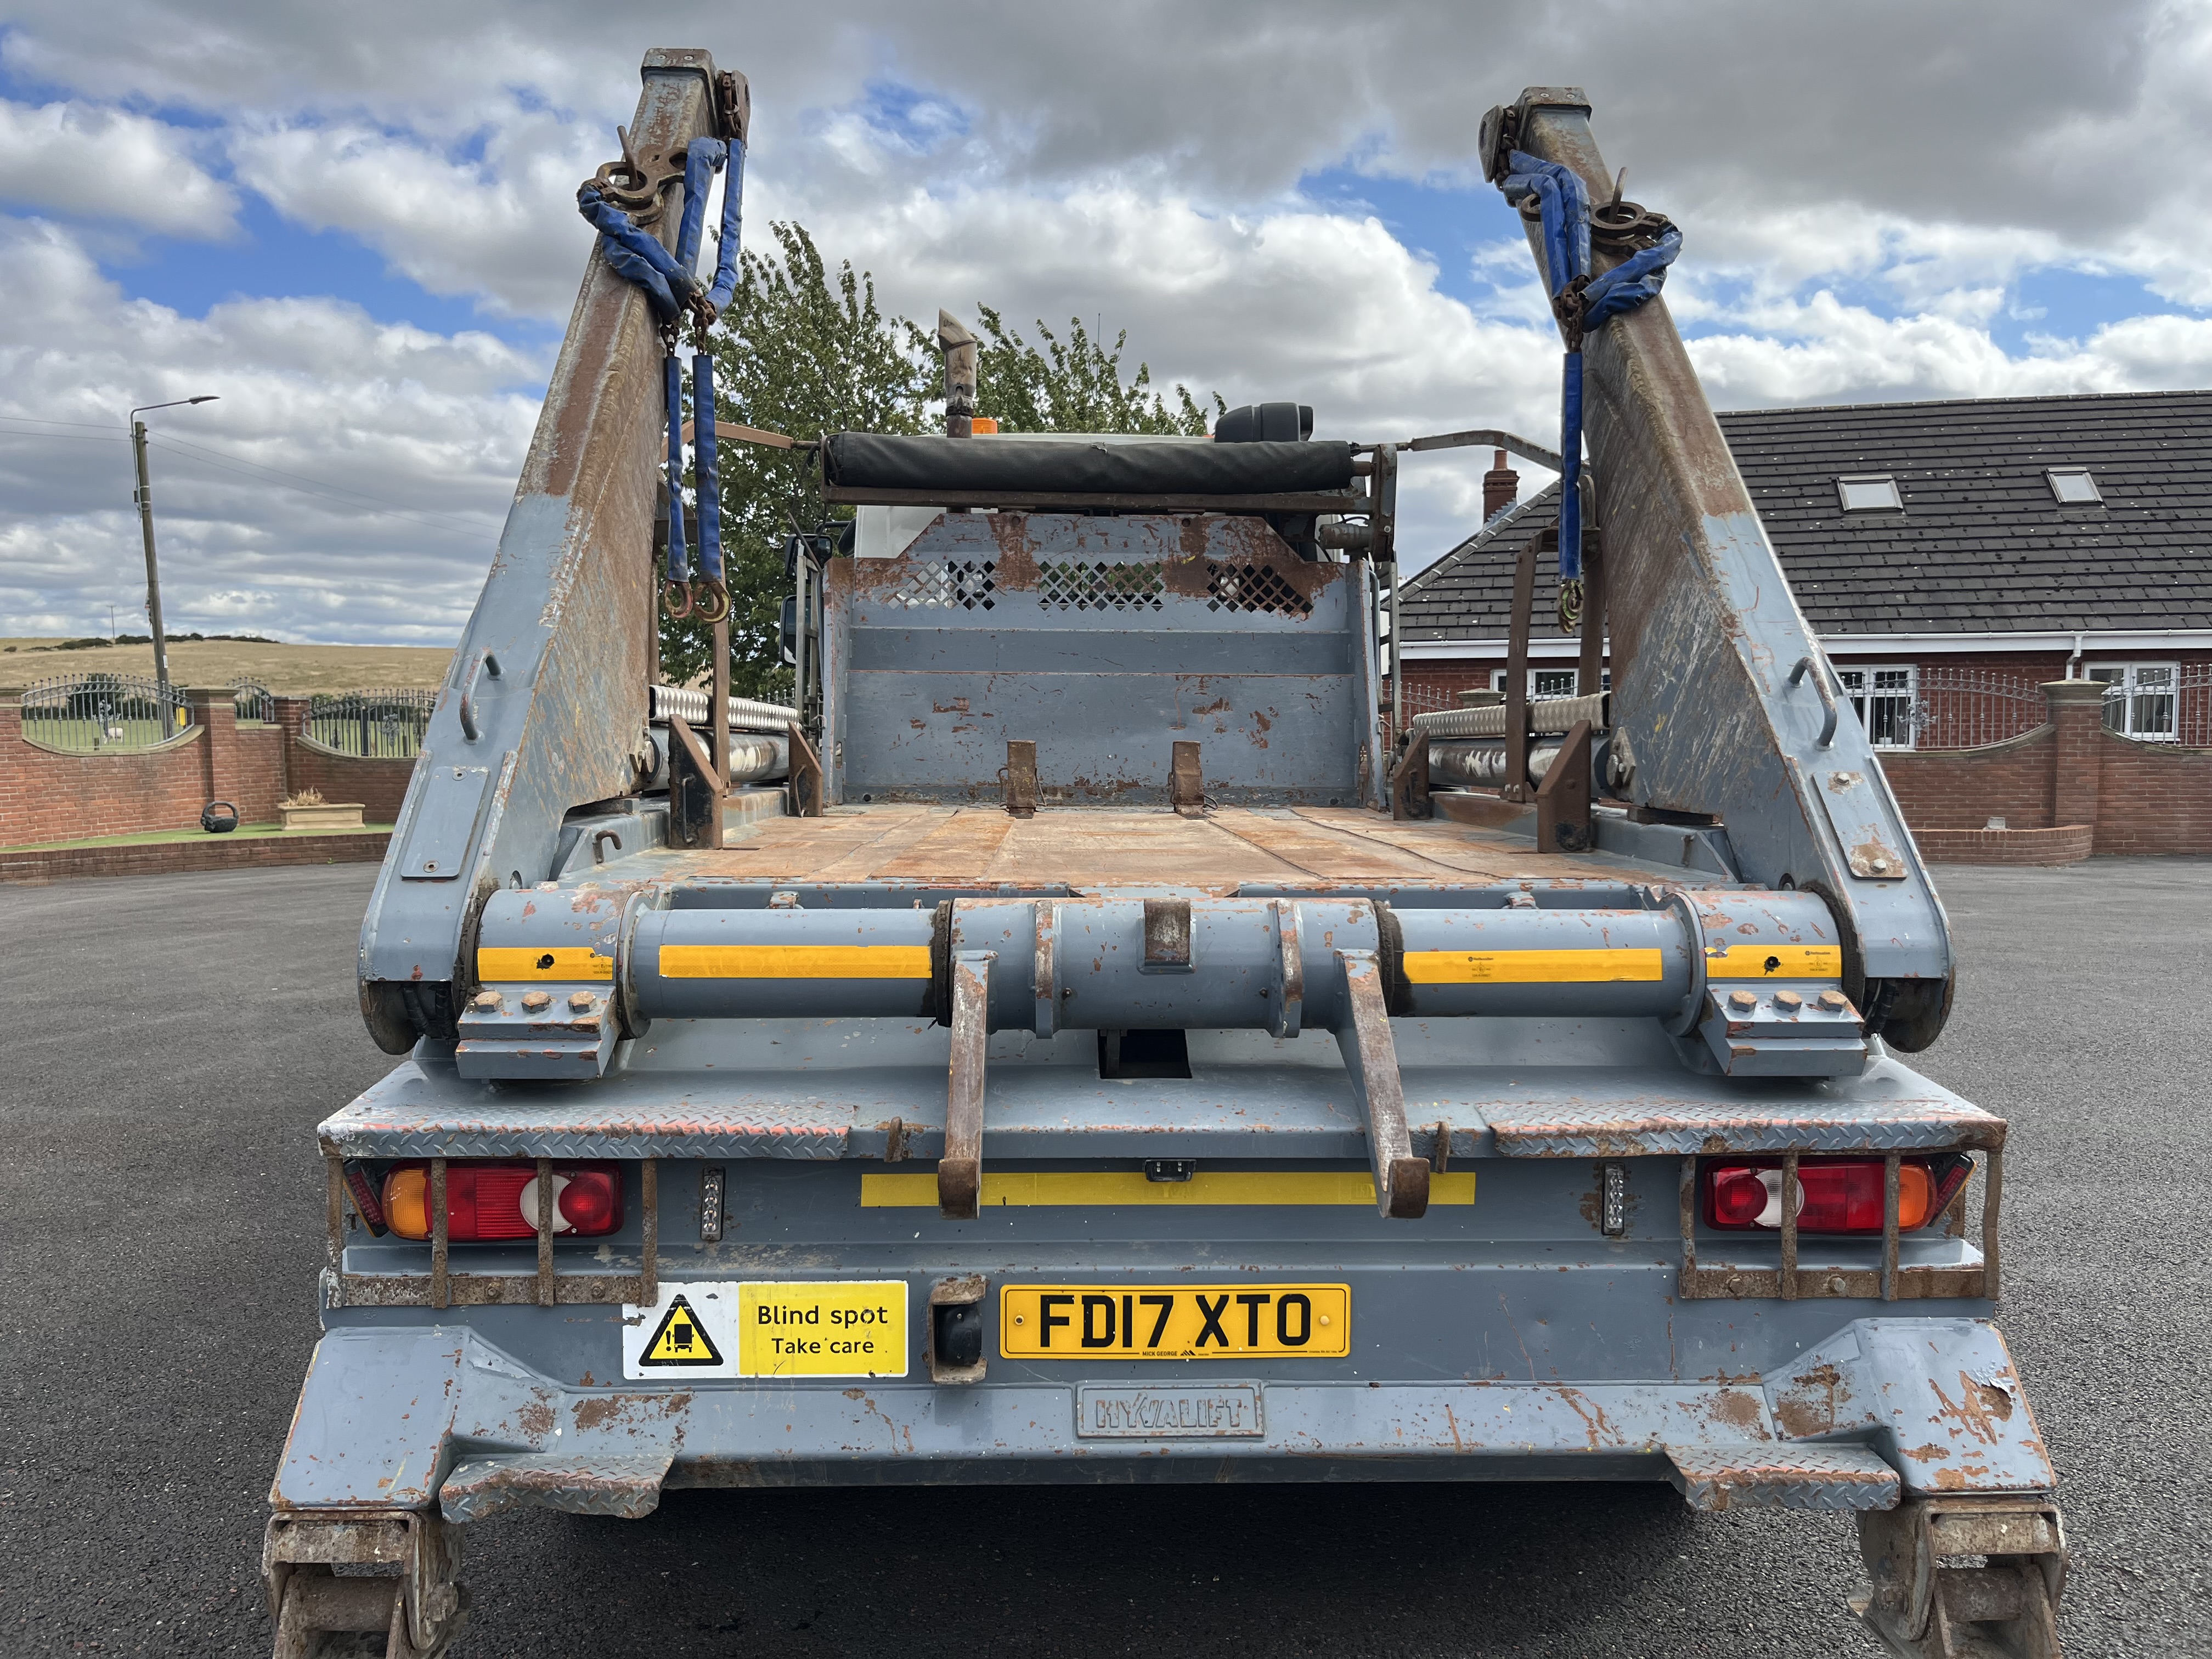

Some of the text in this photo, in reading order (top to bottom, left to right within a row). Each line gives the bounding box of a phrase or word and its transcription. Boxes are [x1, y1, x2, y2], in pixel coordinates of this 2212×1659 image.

[758, 1305, 888, 1329] Blind spot
[1040, 1294, 1311, 1348] FD17 XTO
[771, 1338, 874, 1355] Take care
[1096, 1391, 1242, 1428] HYVALIFT
